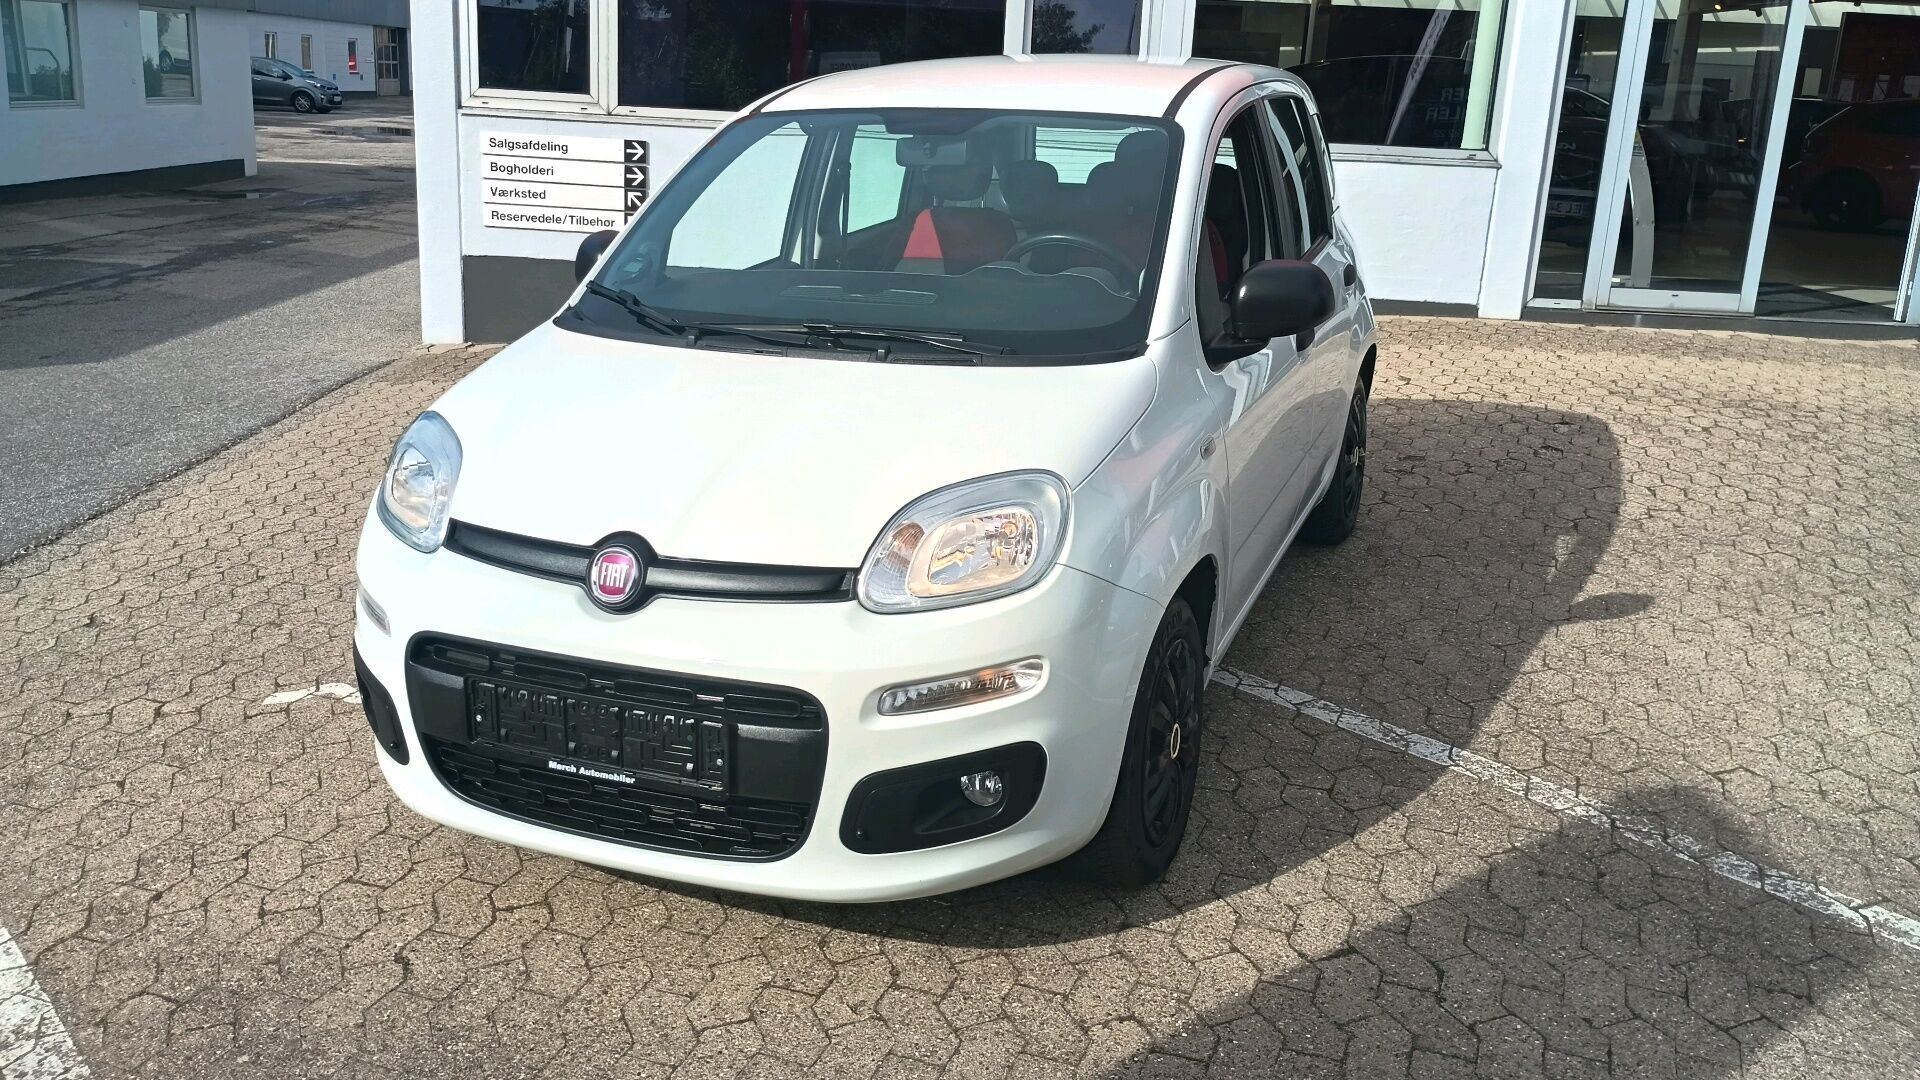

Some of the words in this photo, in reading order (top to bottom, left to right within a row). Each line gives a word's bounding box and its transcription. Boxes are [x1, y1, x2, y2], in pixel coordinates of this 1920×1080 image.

[489, 137, 569, 154] Salgsafdeling
[490, 162, 554, 176] Bogholderi
[490, 186, 546, 200] Værksted
[600, 562, 629, 588] FIAT
[579, 766, 636, 784] Automobiler
